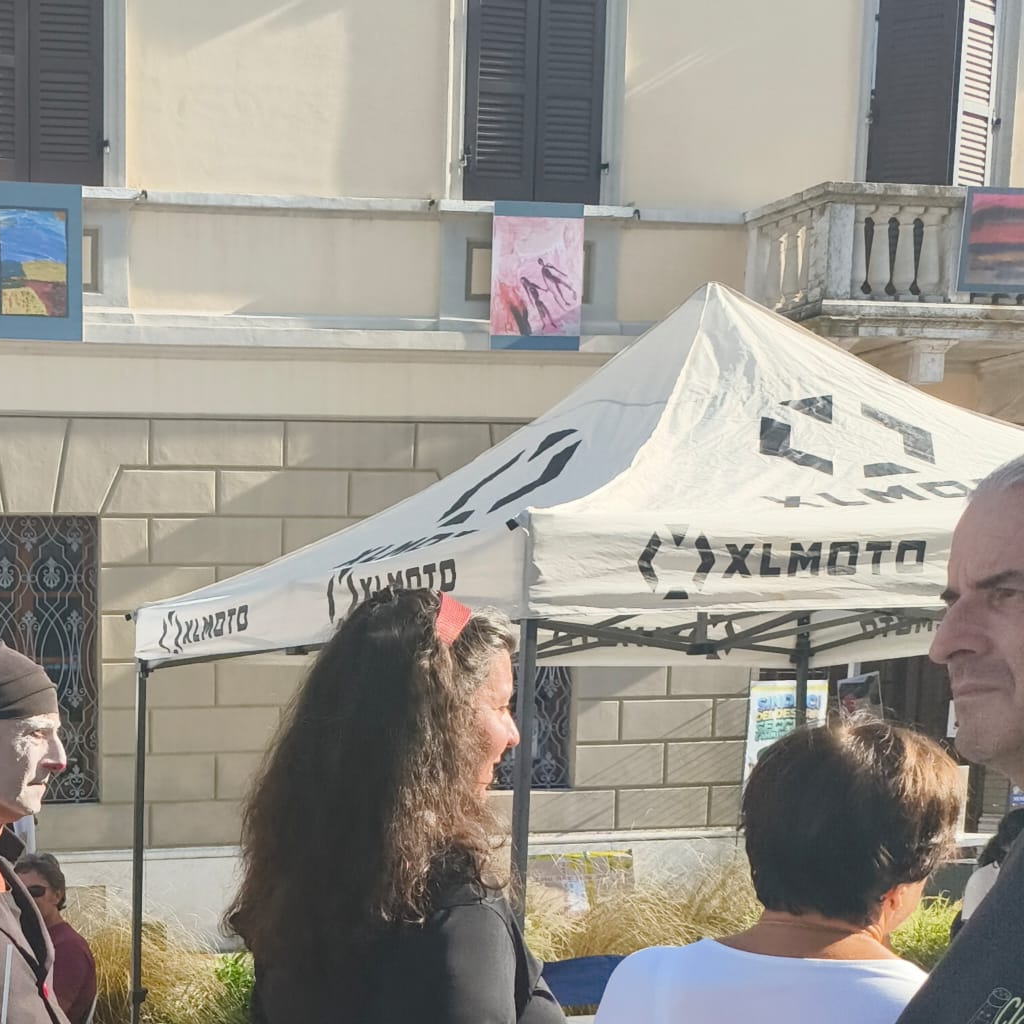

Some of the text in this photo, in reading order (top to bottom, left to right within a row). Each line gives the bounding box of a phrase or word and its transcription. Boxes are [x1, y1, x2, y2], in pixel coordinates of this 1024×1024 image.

[760, 478, 984, 509] XLMO
[332, 529, 480, 569] XLMO
[722, 540, 927, 579] XLMOTO
[182, 604, 249, 645] XLMOTO
